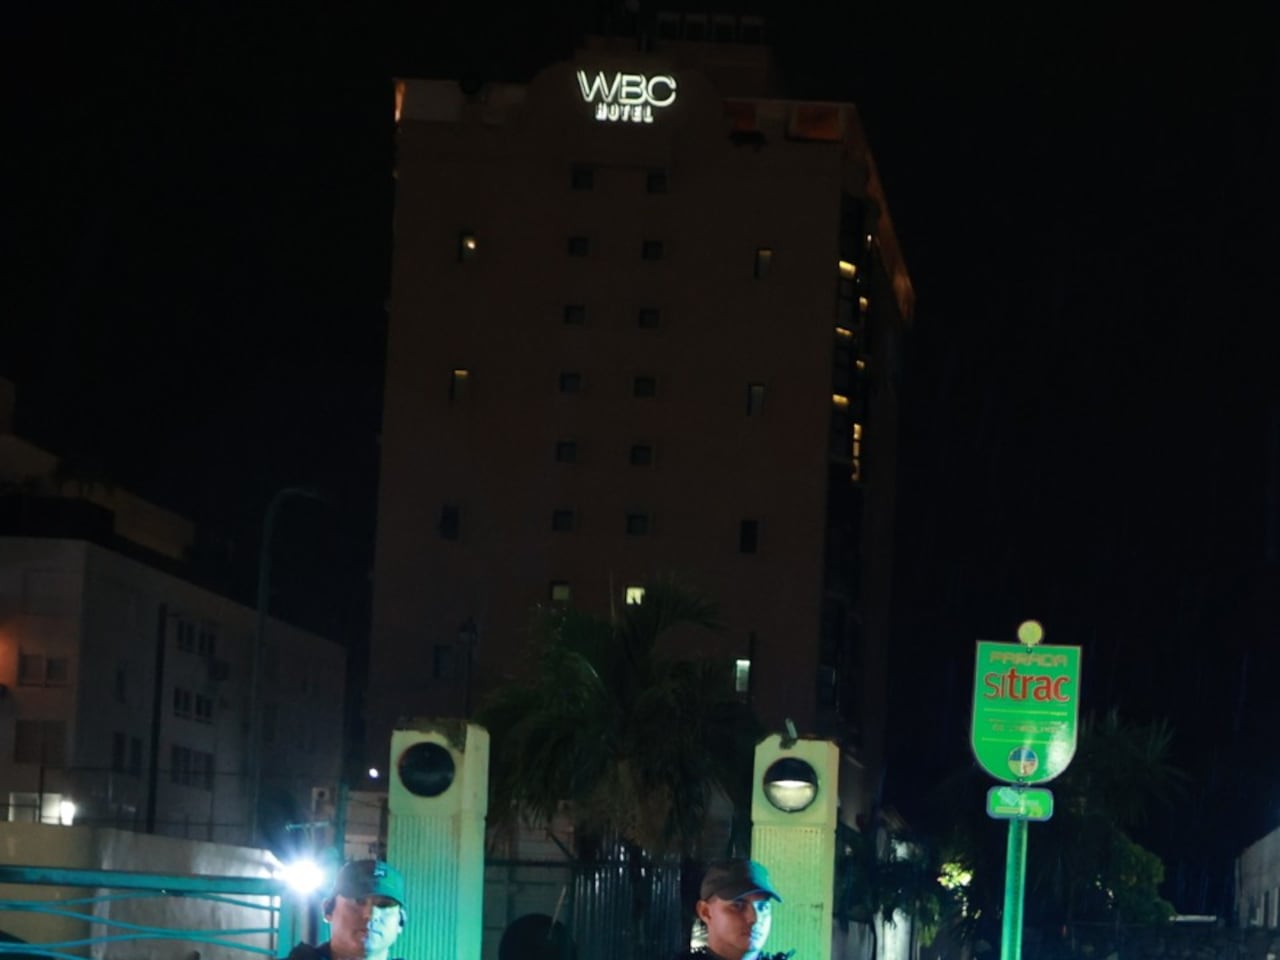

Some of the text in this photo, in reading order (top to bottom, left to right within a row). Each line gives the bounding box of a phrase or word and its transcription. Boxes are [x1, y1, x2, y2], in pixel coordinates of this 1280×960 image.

[577, 70, 677, 107] WBC
[596, 102, 654, 123] HOTEL
[990, 651, 1068, 667] PARADA
[984, 667, 1071, 702] sitrac
